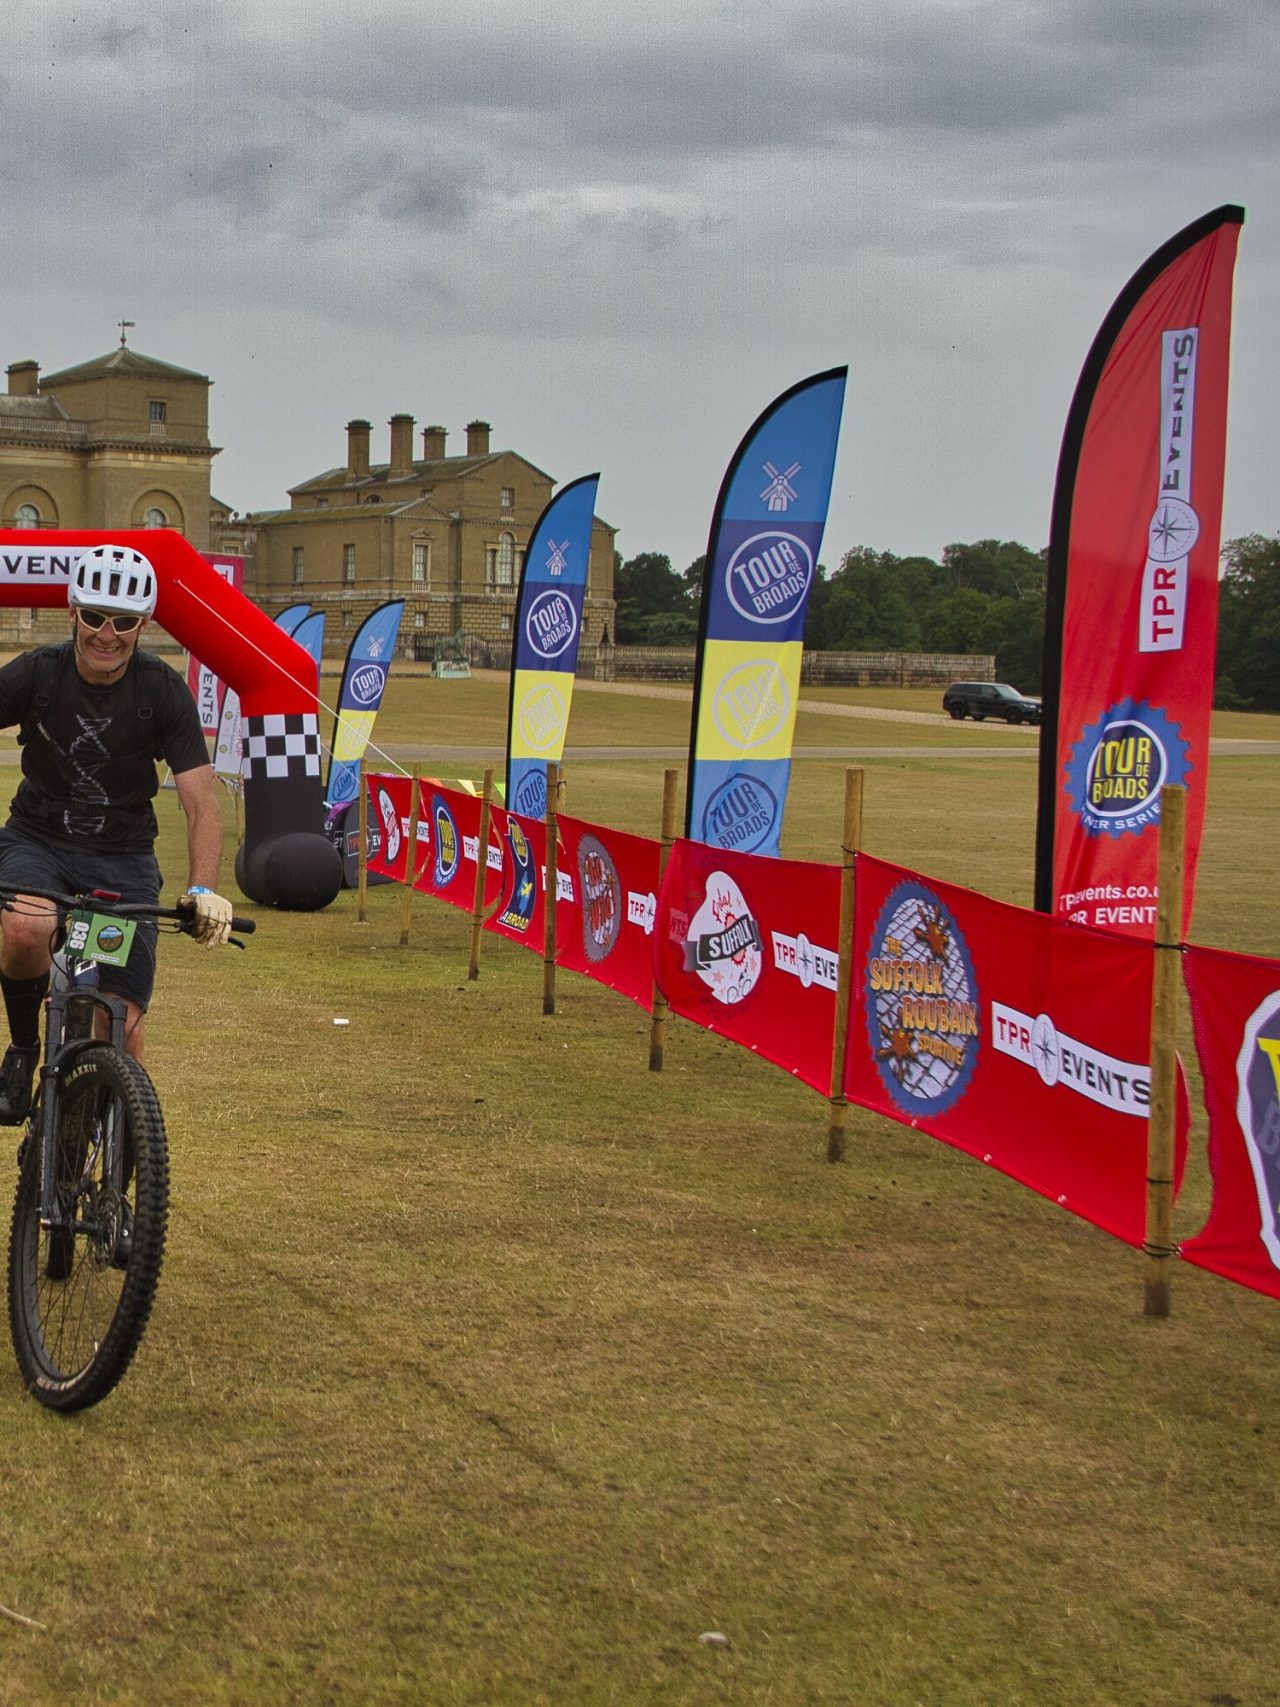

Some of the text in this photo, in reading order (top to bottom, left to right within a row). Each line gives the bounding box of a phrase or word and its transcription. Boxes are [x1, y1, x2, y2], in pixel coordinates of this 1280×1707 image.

[1151, 333, 1194, 643] TPR EVENTS
[734, 540, 796, 595] TOUR
[787, 560, 802, 574] DE
[752, 571, 806, 614] BROADS
[531, 597, 565, 637] TOUR
[540, 620, 571, 651] BROADS
[202, 672, 213, 725] ENTS
[354, 668, 380, 693] TOUR
[1094, 736, 1152, 778] TOUR
[1135, 763, 1149, 778] DE
[750, 799, 764, 813] DE
[1092, 778, 1149, 804] BOADS
[717, 811, 771, 850] BROADS
[488, 850, 502, 866] ENTS
[499, 910, 530, 931] ABROAD
[630, 900, 646, 919] TPR
[1094, 906, 1158, 925] EVENT
[69, 921, 89, 950] 036
[708, 918, 754, 958] SUFFOLK
[775, 942, 839, 982] TPR EVE
[869, 957, 944, 995] SUFFOLK
[901, 994, 978, 1036] ROUBAIX
[996, 1015, 1150, 1106] TPR EVENTS
